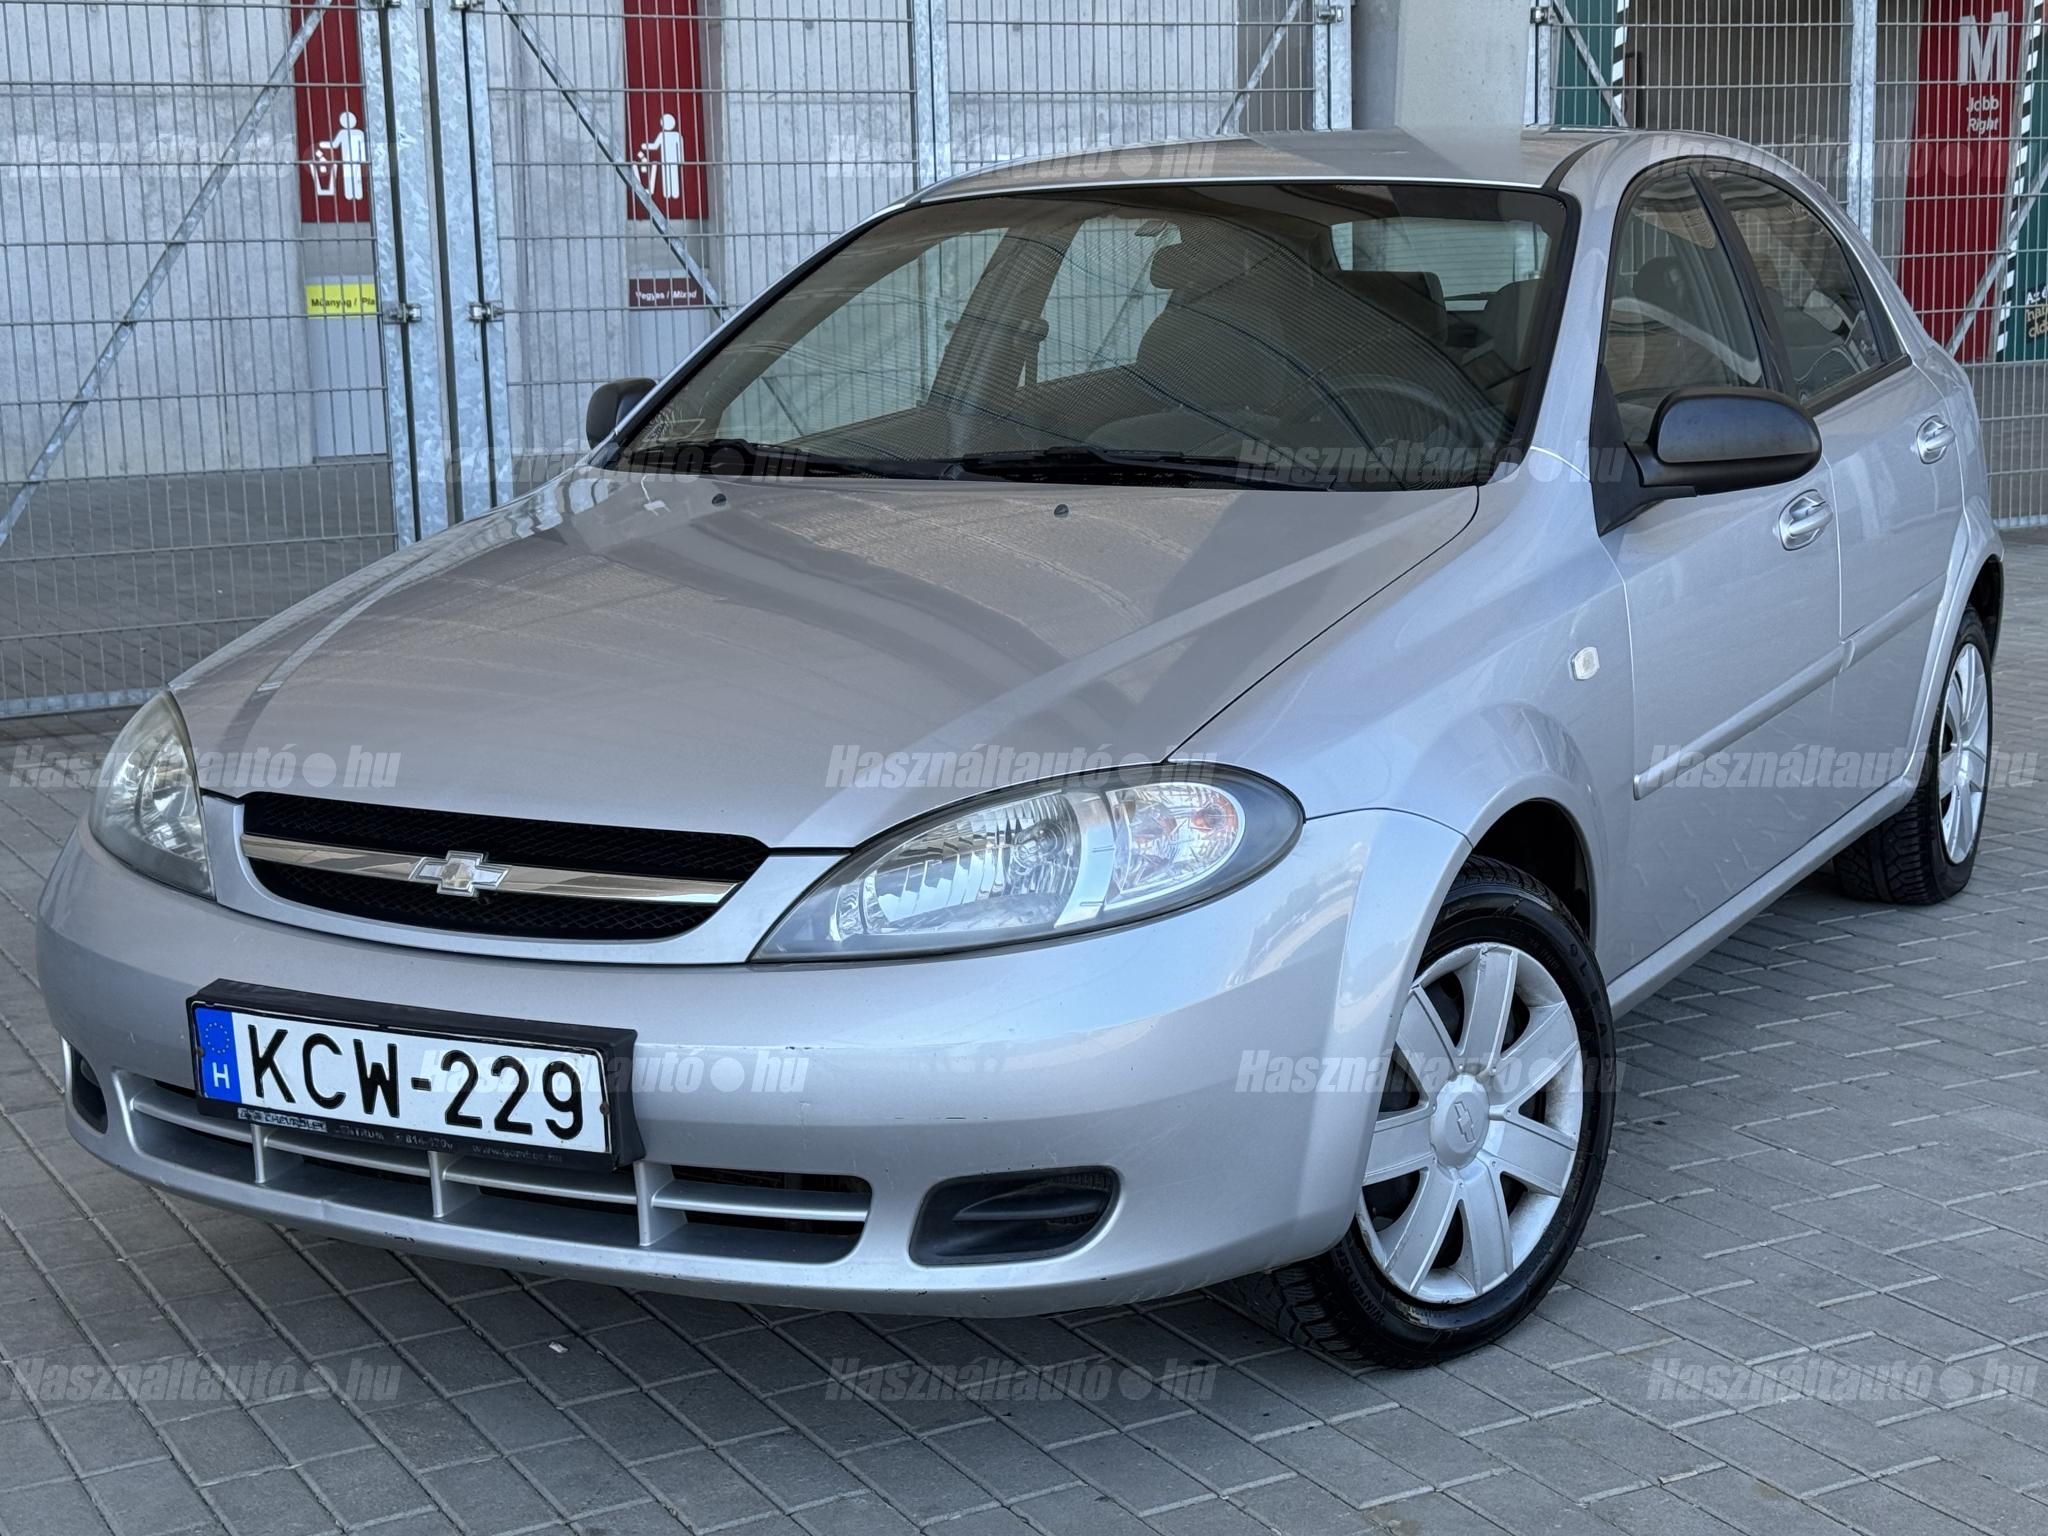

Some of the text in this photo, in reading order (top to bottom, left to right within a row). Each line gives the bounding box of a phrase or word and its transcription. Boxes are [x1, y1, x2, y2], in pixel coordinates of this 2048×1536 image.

[1957, 11, 2008, 86] M
[1966, 95, 1999, 112] Jobb
[1967, 118, 1998, 134] Right
[361, 297, 375, 305] Pla
[213, 1023, 585, 1141] H KCW-229
